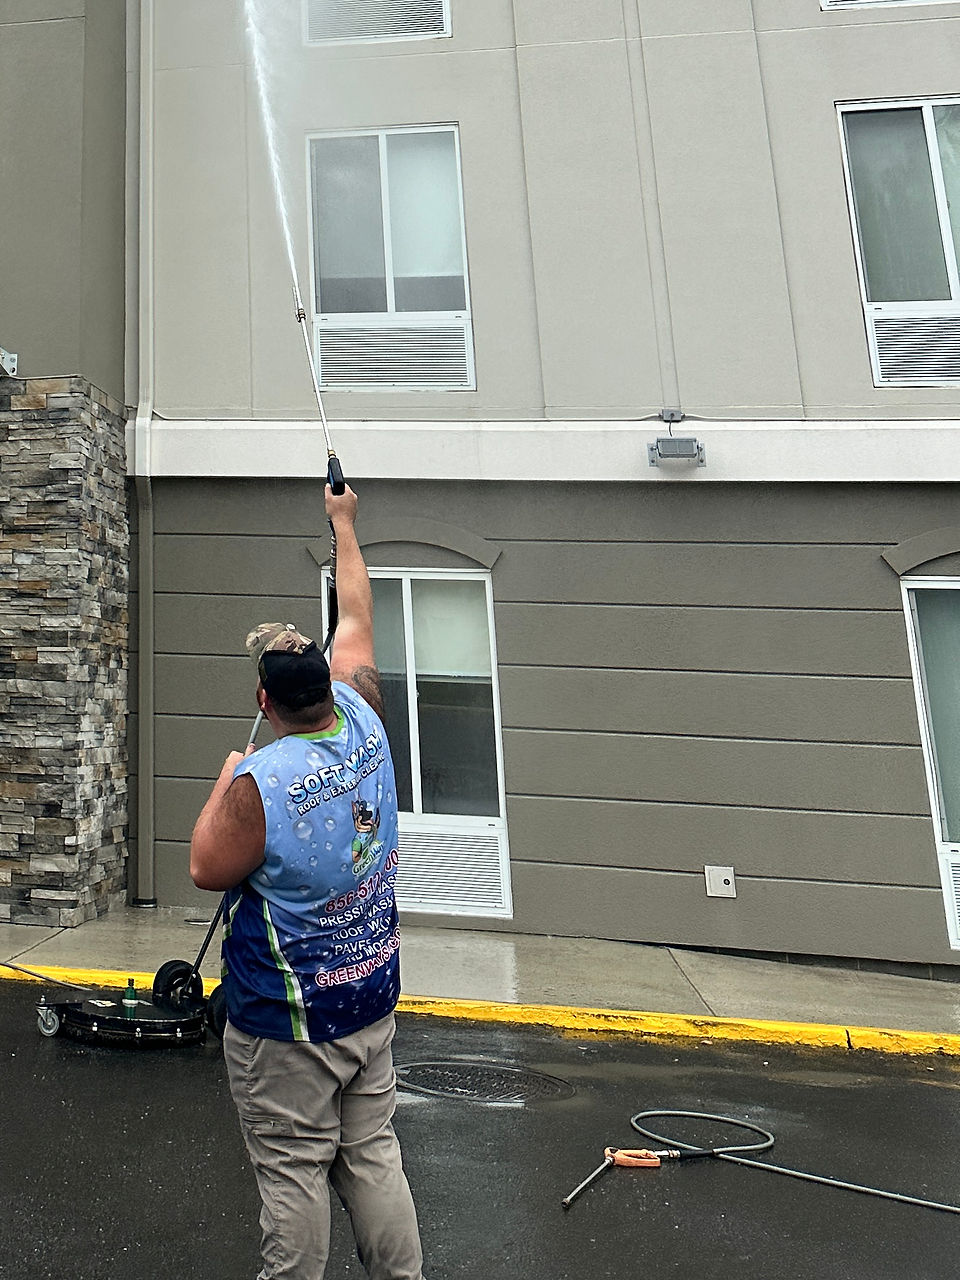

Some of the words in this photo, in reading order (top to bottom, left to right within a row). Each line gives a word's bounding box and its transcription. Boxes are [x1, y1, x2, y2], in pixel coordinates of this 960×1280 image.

[288, 763, 345, 805] SOFT
[296, 794, 321, 816] ROOF
[321, 791, 331, 803] &
